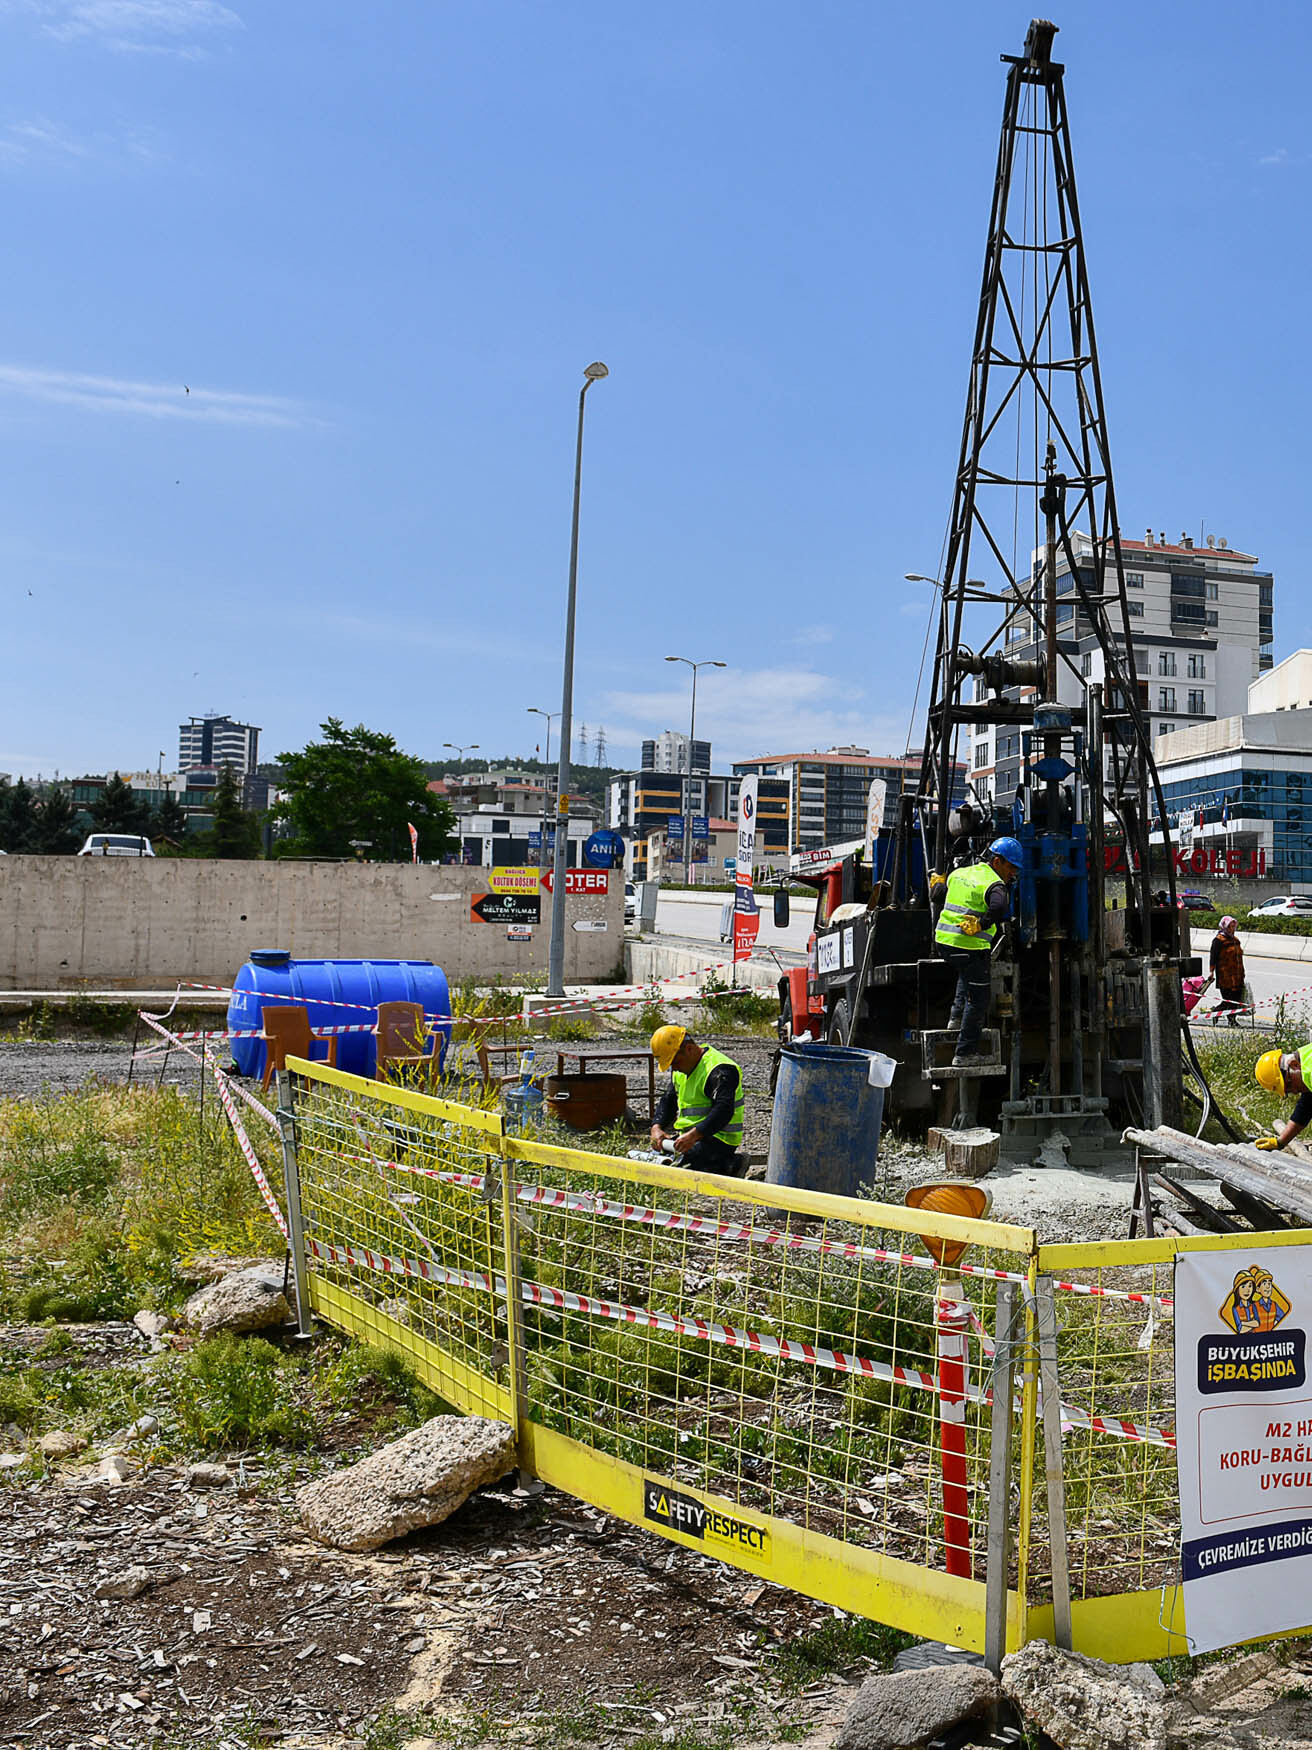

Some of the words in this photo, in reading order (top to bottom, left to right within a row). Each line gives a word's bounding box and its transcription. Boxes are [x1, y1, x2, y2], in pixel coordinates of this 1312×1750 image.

[1172, 847, 1266, 876] KOLEJİ
[493, 875, 513, 888] KOLTUK
[514, 875, 537, 888] DÖŞEME
[1208, 1341, 1295, 1361] BÜYÜKŞEHİR
[1207, 1359, 1297, 1383] İŞBAŞINDA
[1265, 1422, 1292, 1439] M2
[1198, 1536, 1266, 1569] ÇEVREMİZE
